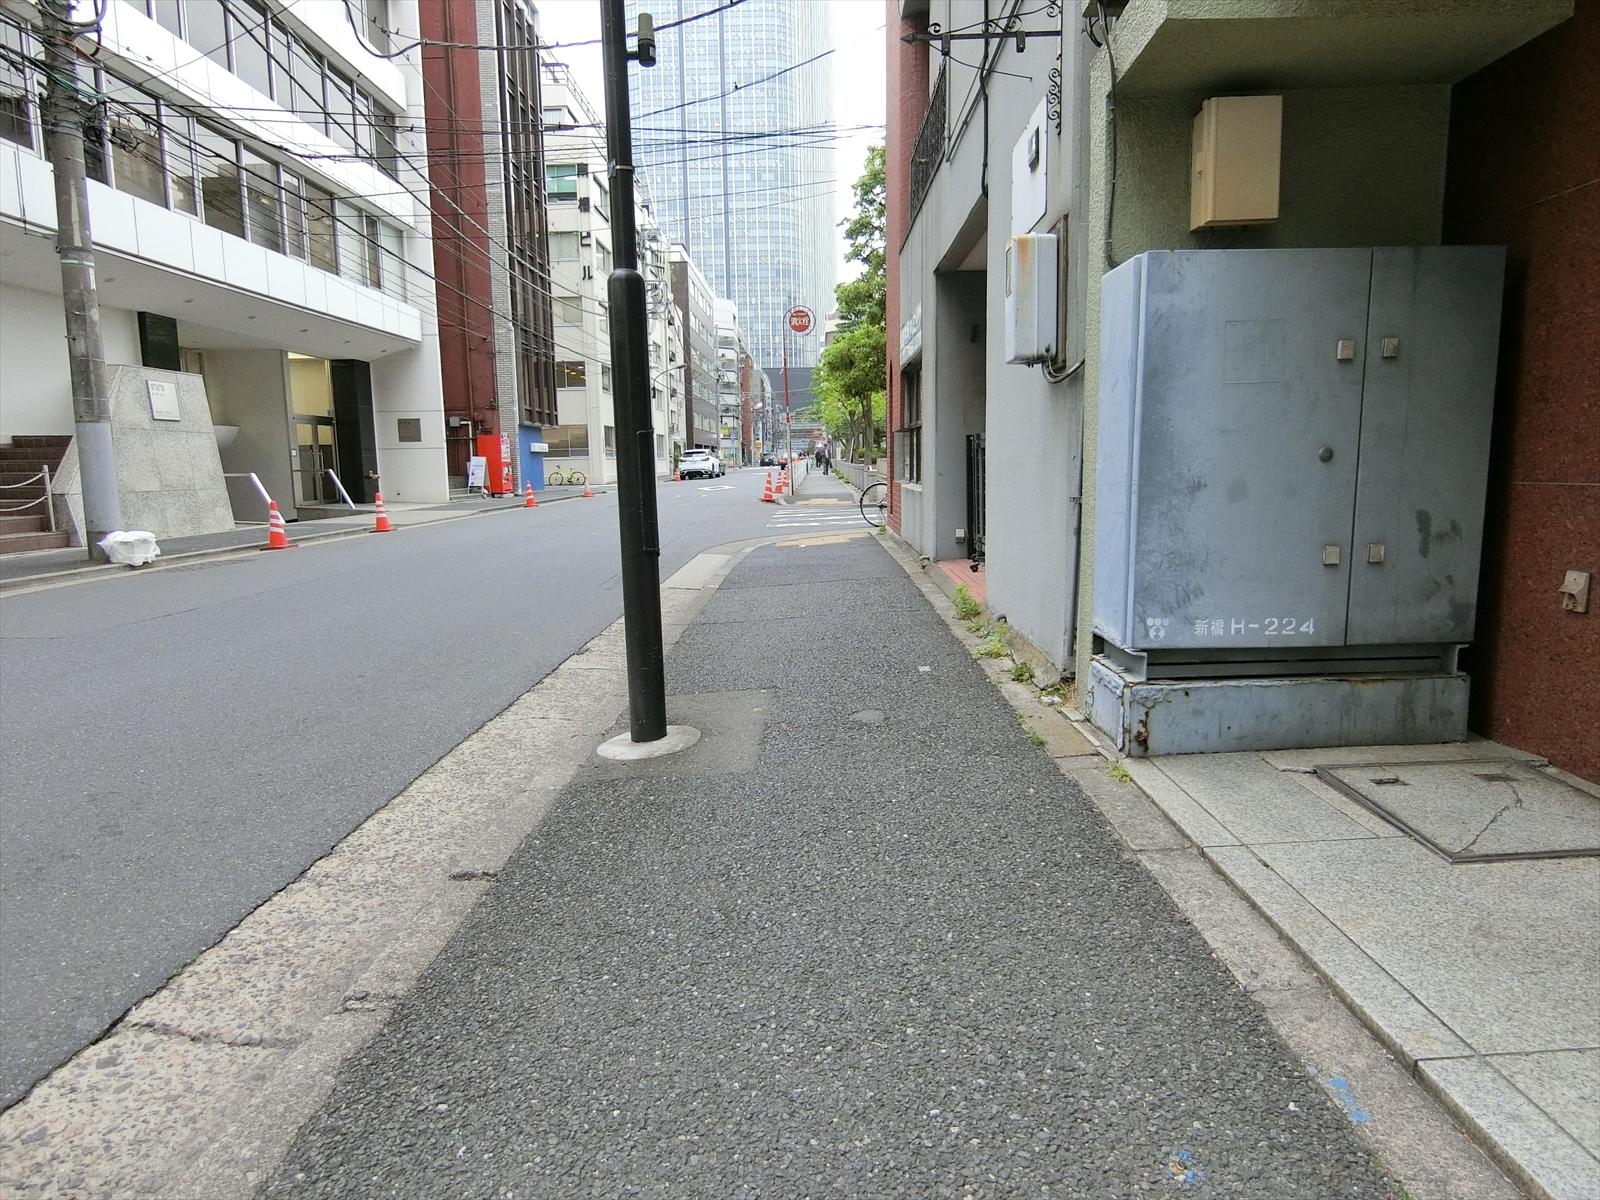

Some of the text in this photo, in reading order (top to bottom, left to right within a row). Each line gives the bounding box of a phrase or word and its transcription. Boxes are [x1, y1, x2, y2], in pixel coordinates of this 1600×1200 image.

[790, 316, 809, 326] 消火栓
[1194, 618, 1314, 636] 新橋 H-224
